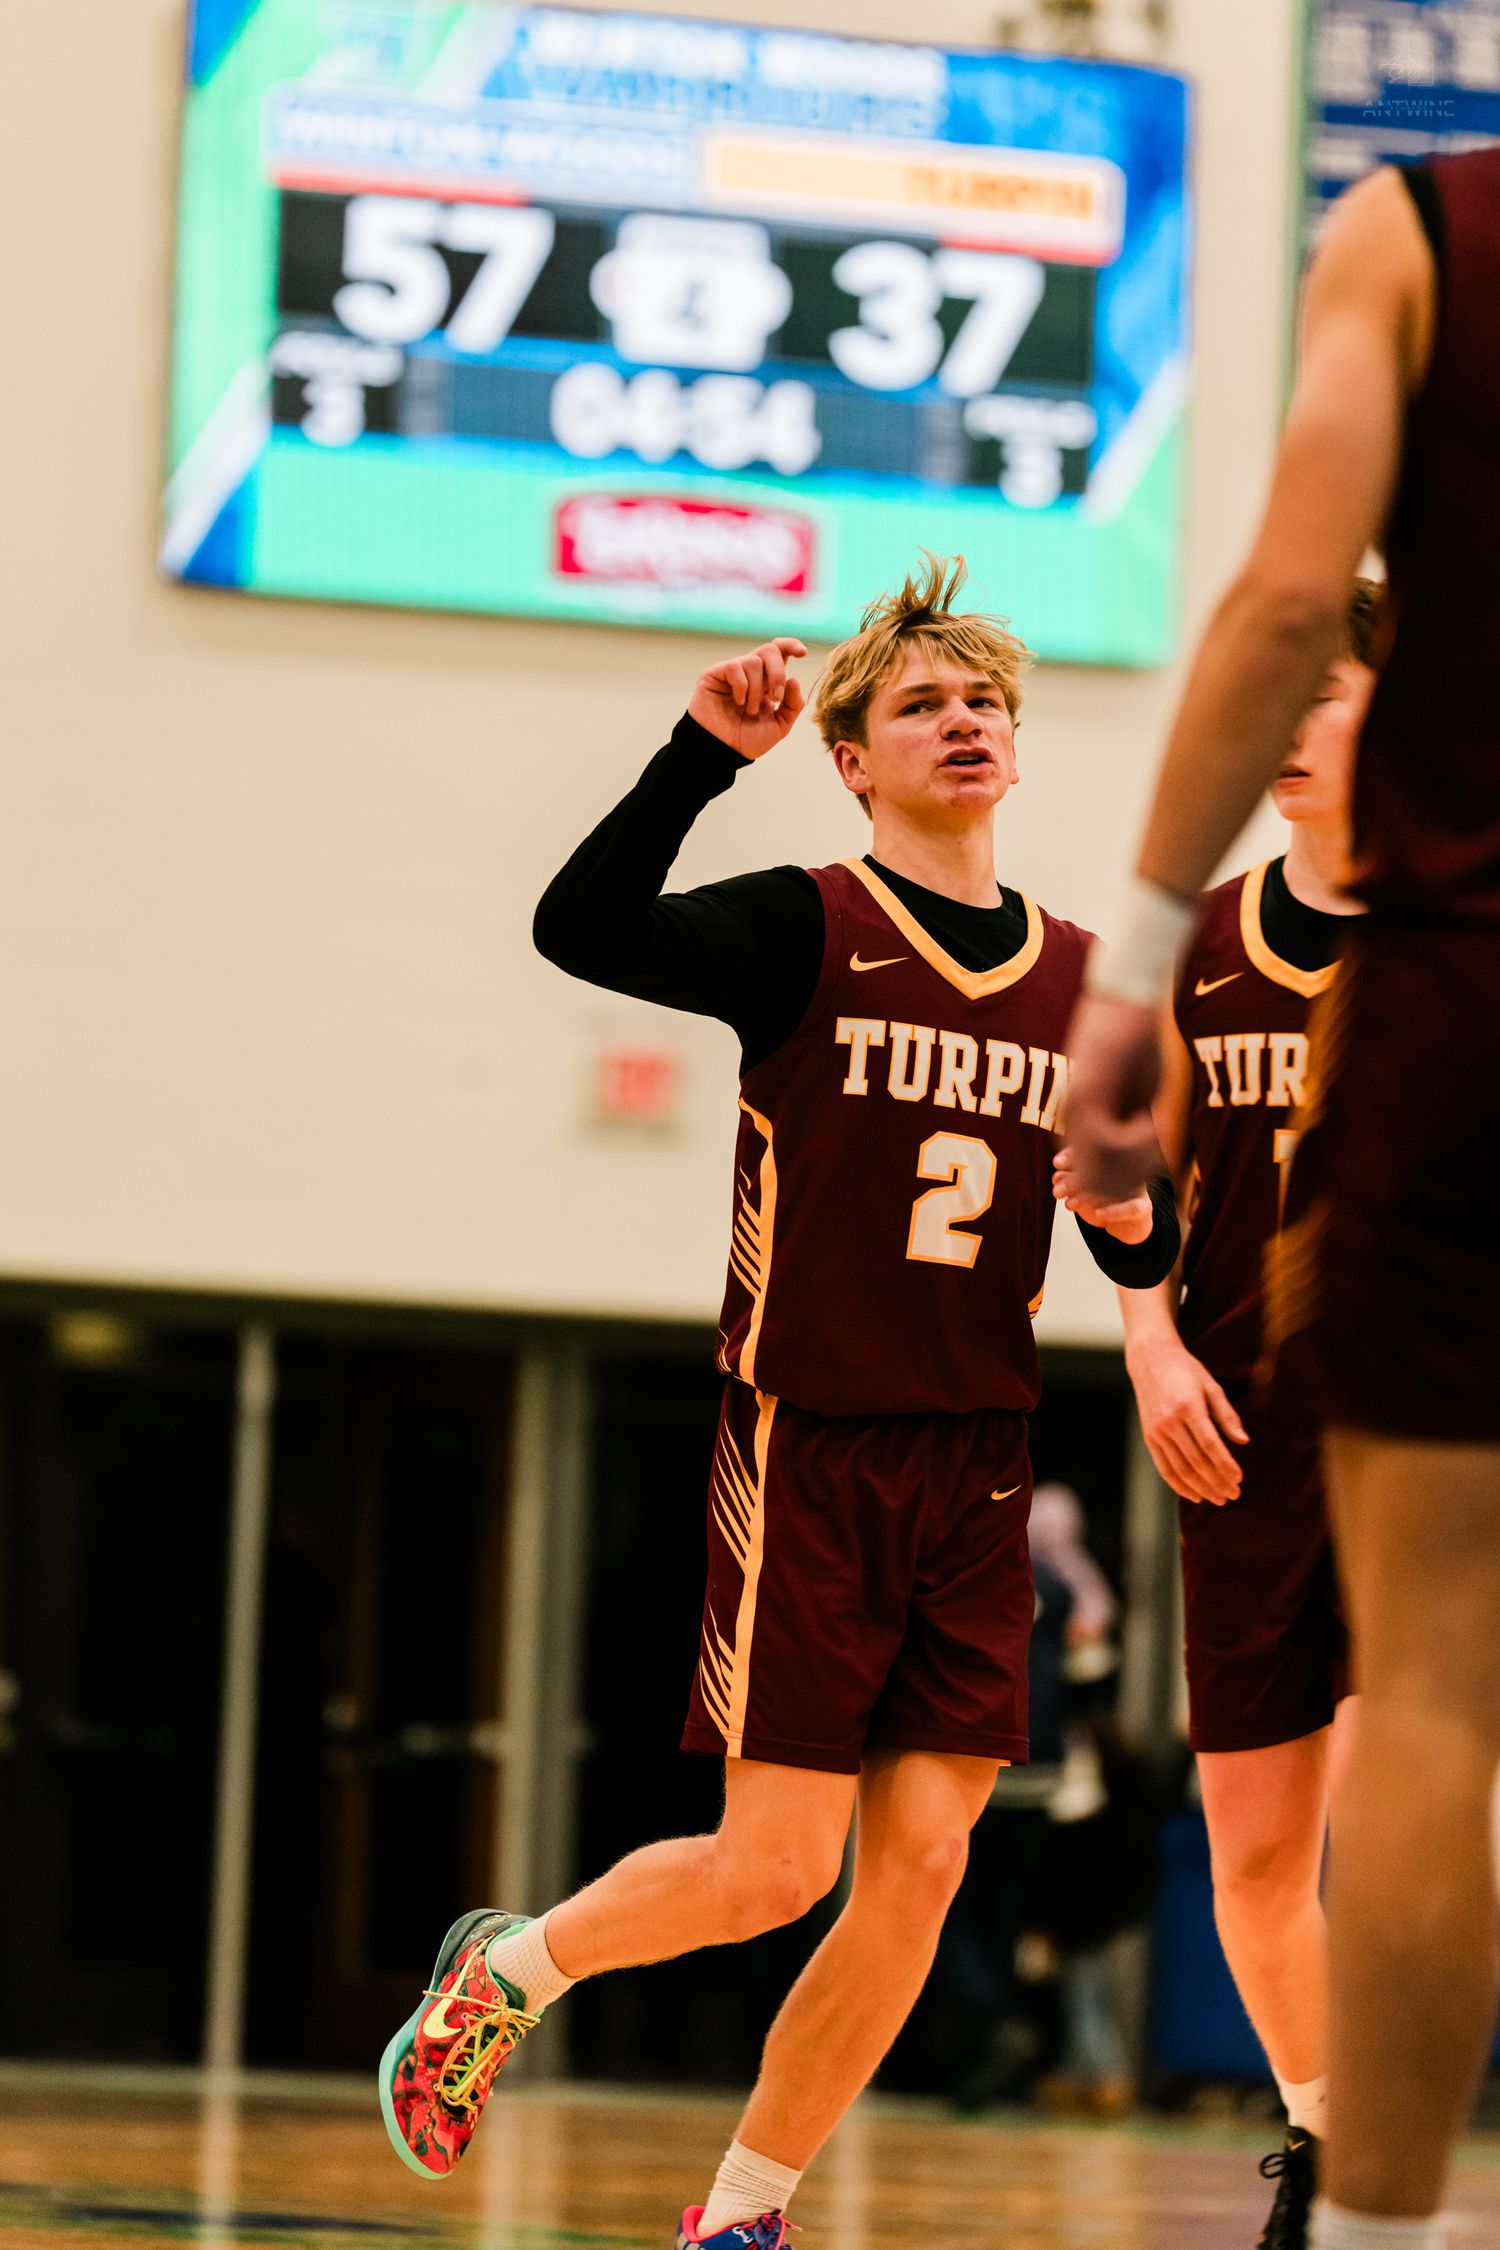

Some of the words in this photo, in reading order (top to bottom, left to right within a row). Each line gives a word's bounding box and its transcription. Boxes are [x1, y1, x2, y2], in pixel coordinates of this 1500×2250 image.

[333, 195, 555, 353] 57
[829, 241, 1046, 395] 37
[906, 1131, 997, 1269] 2
